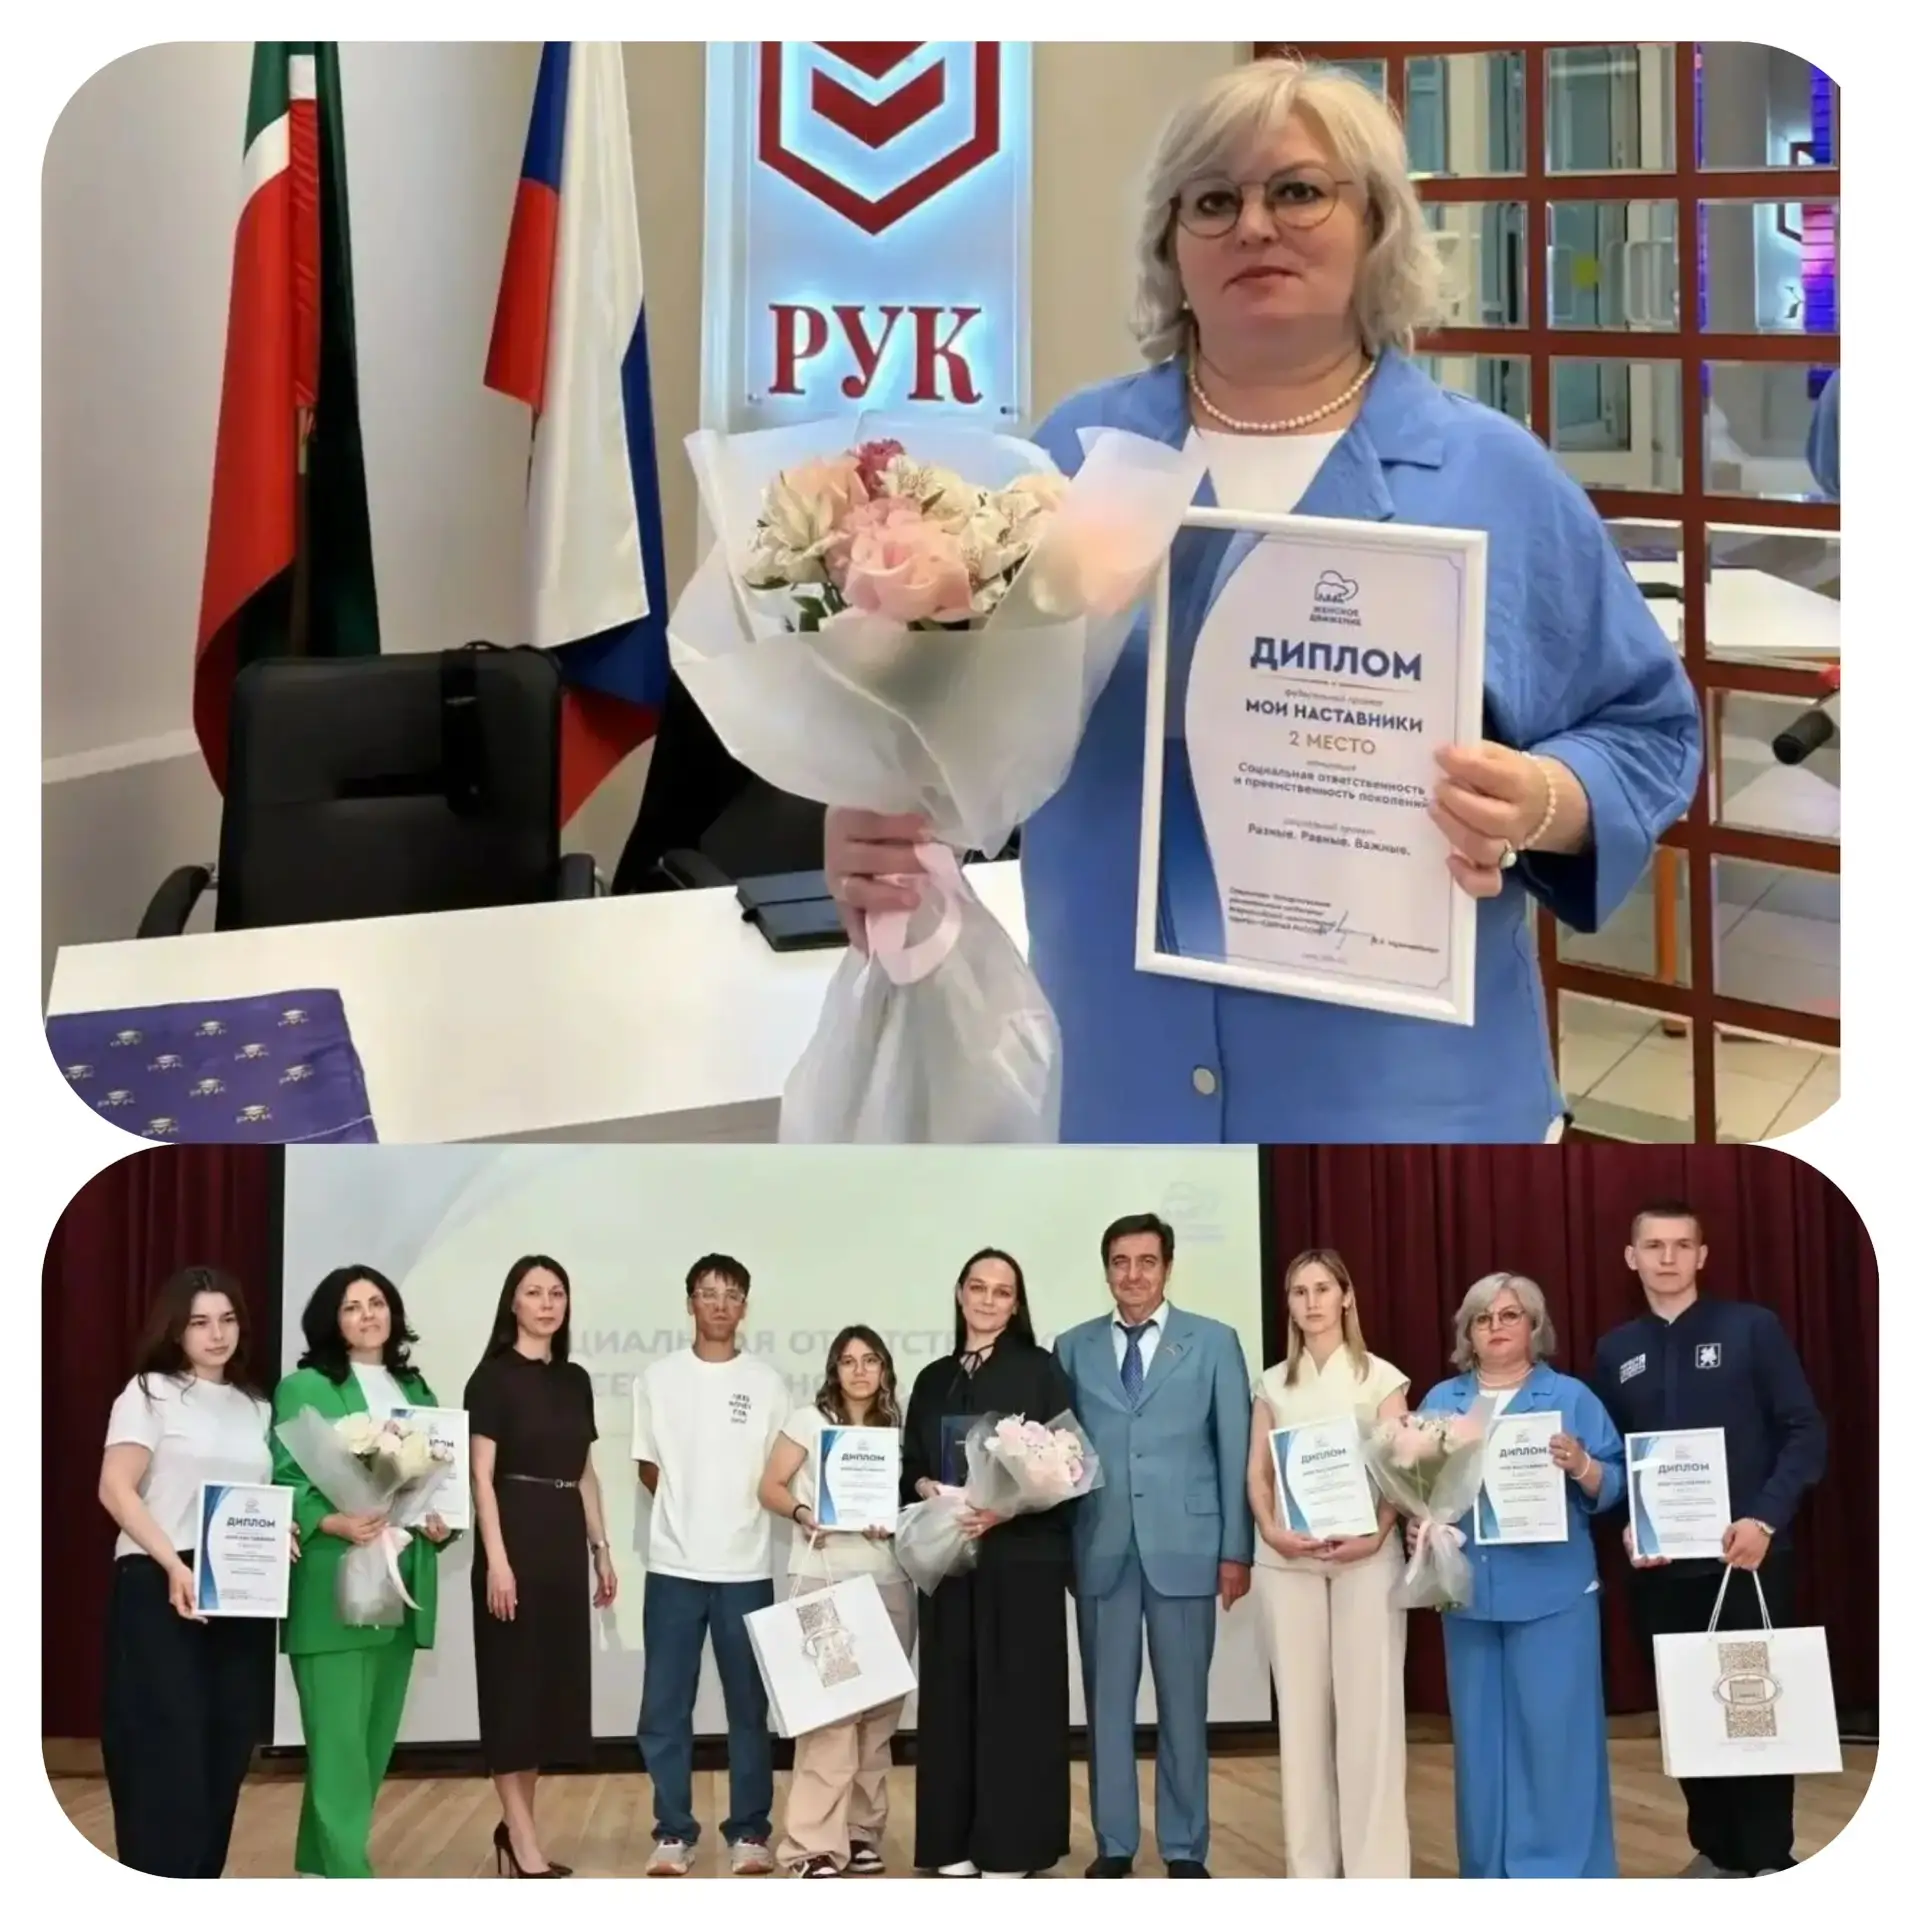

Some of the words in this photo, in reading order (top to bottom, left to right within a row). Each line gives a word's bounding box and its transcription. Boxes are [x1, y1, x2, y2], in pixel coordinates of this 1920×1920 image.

[767, 303, 983, 405] РУК
[1249, 636, 1422, 681] ДИПЛОМ
[1246, 698, 1288, 717] МОИ
[1294, 703, 1424, 733] НАСТАВНИКИ
[1288, 730, 1300, 747] 2
[1306, 733, 1377, 756] МЕСТО
[1233, 776, 1243, 786] и
[1245, 777, 1356, 800] преемственность
[1238, 761, 1315, 782] Социальная
[1317, 774, 1426, 796] ответственность
[841, 1452, 886, 1462] ДИПЛОМ
[1499, 1446, 1548, 1459] ДИПЛОМ
[1657, 1463, 1710, 1475] ДИПЛОМ
[226, 1516, 276, 1529] ДИПЛОМ
